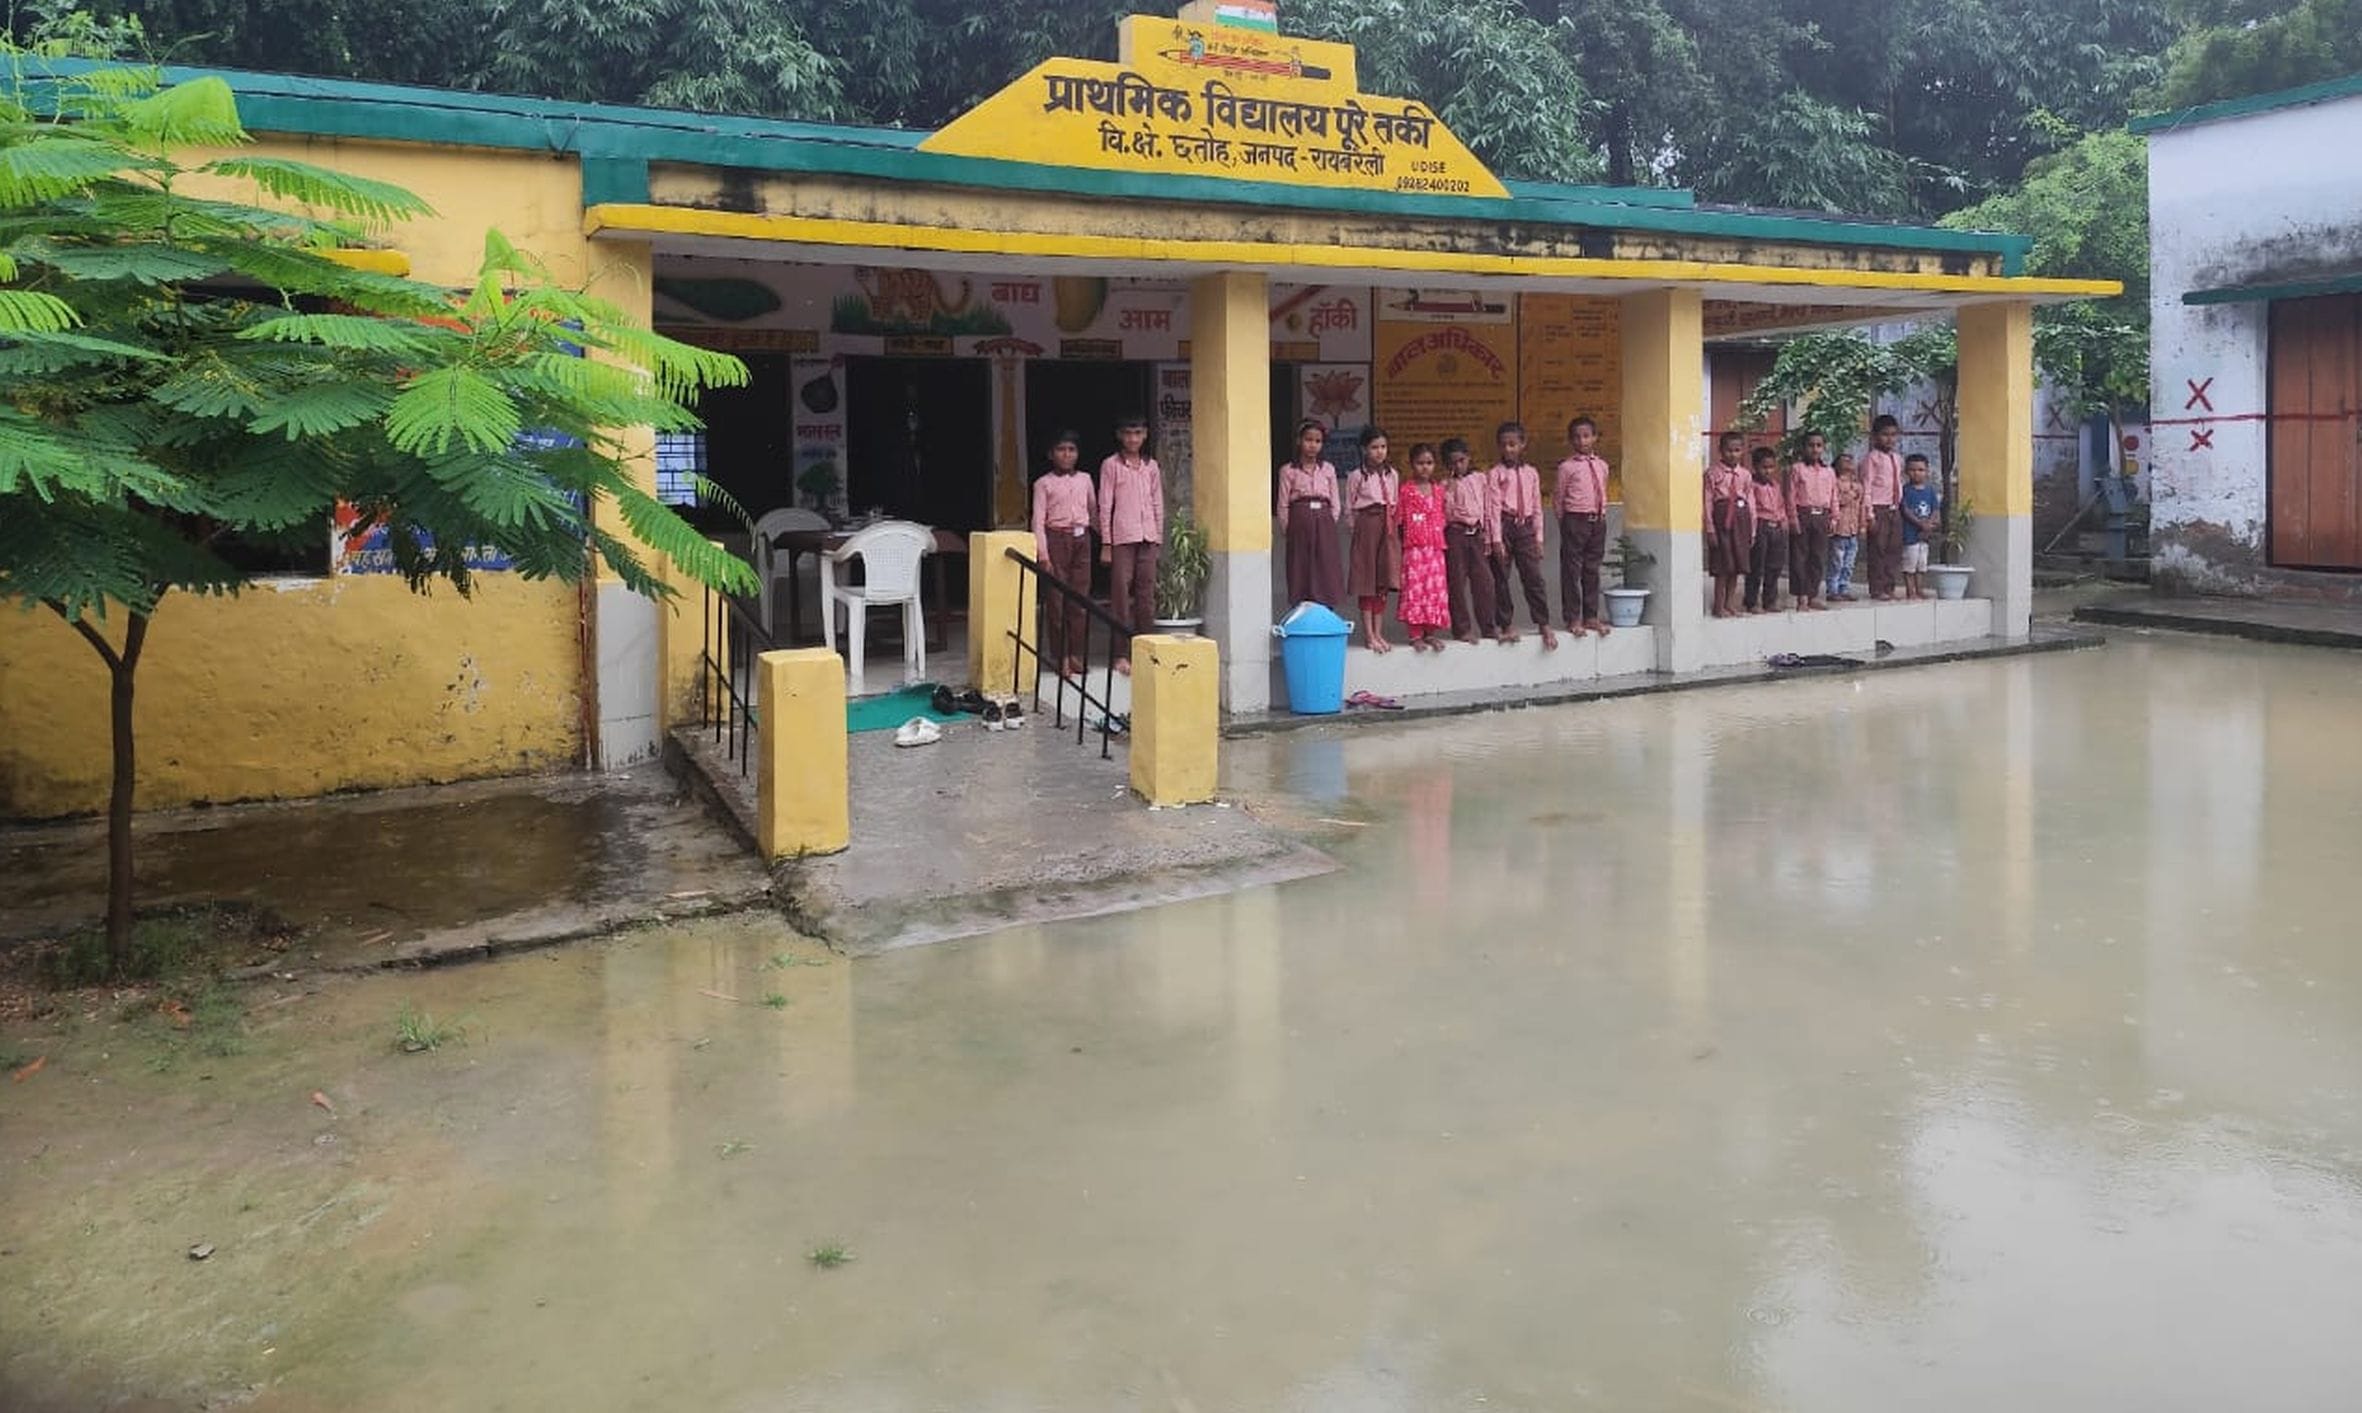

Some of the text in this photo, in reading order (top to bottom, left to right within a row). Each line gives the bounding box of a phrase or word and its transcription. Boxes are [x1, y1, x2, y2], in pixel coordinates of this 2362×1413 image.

[1043, 72, 1434, 150] प्राथमिक विद्यालय पूरे तकी
[1411, 160, 1447, 174] UDISE
[1118, 307, 1171, 333] आम
[1308, 297, 1357, 340] हॉकी
